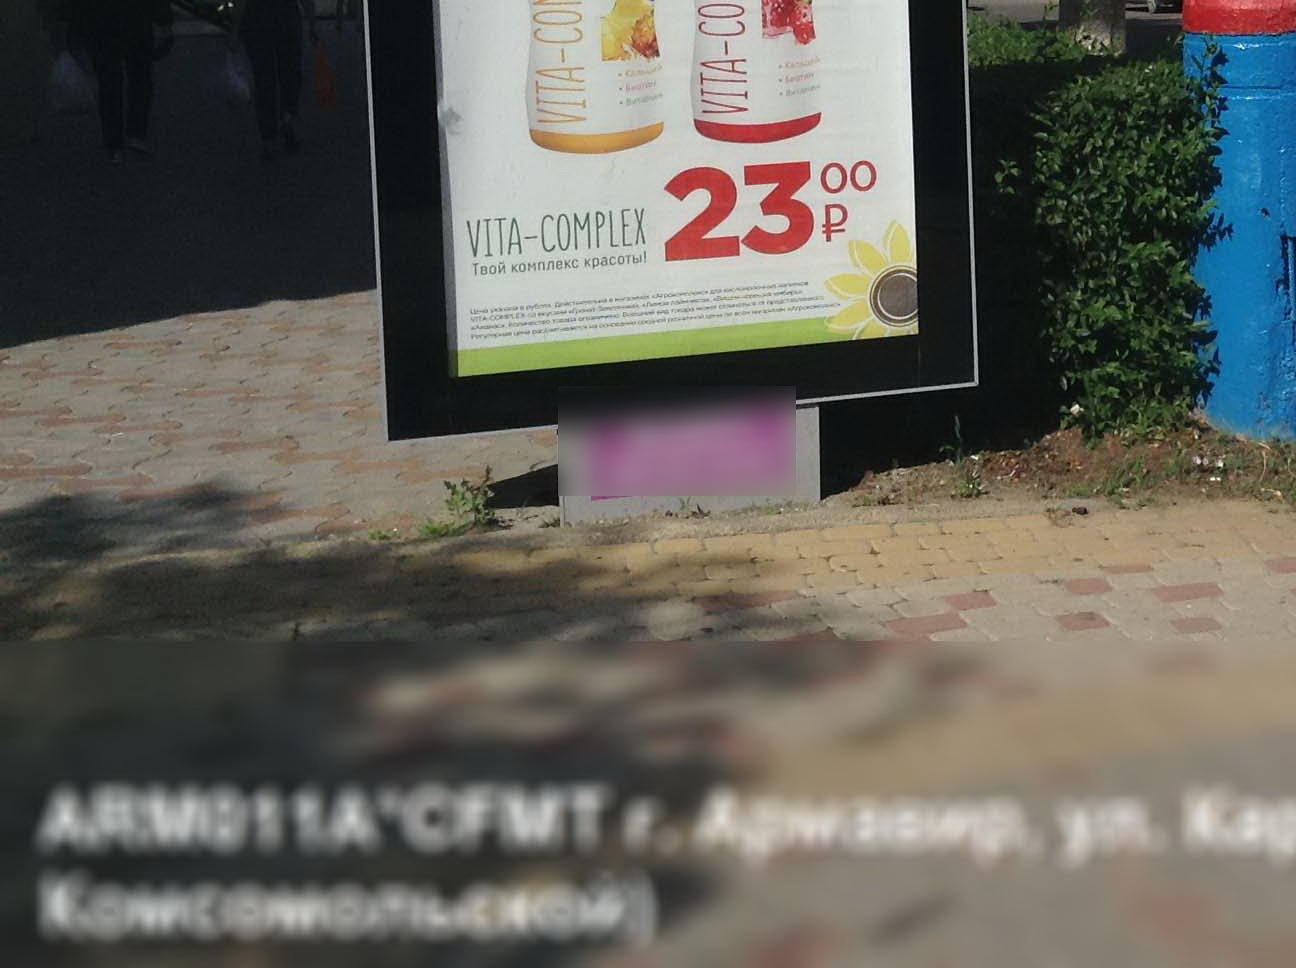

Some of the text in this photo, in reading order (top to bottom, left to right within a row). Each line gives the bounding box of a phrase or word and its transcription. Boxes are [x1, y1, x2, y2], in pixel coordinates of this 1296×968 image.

[466, 208, 646, 258] VITA-COMPLEX
[664, 160, 877, 261] 23 00
[472, 250, 647, 277] Твой комплекс красоты!
